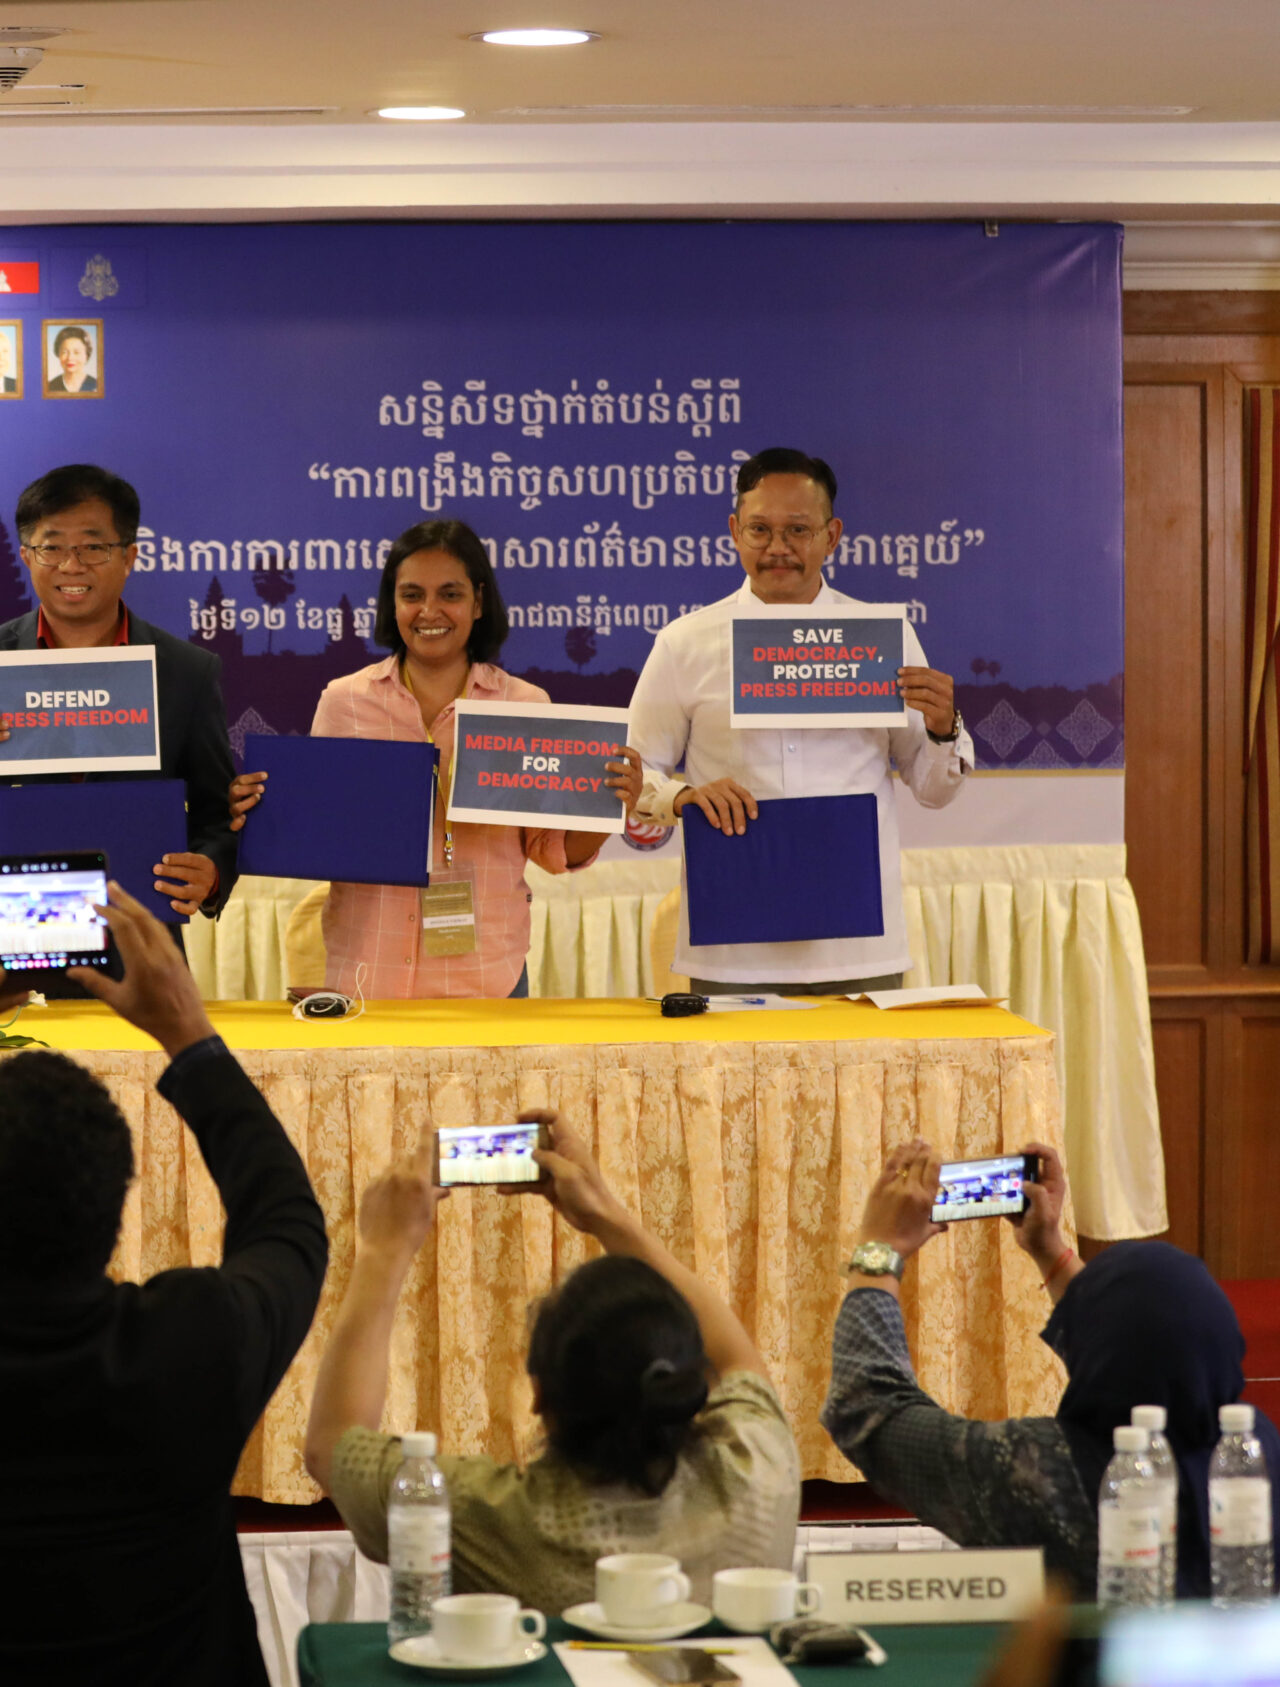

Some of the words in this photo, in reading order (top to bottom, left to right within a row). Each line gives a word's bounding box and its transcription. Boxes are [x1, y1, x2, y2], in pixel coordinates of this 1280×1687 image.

[792, 628, 844, 644] SAVE
[752, 646, 883, 663] DEMOCRACY,
[773, 663, 861, 680] PROTECT
[740, 682, 798, 698] PRESS
[801, 680, 898, 697] FREEDOM!
[25, 689, 111, 709] DEFEND
[0, 711, 50, 728] RESS
[53, 708, 149, 727] FREEDOM
[465, 734, 527, 753] MEDIA
[530, 738, 619, 757] FREEDOM
[522, 755, 561, 773] FOR
[477, 771, 602, 793] DEMOCRACY
[845, 1577, 1007, 1601] RESERVED
